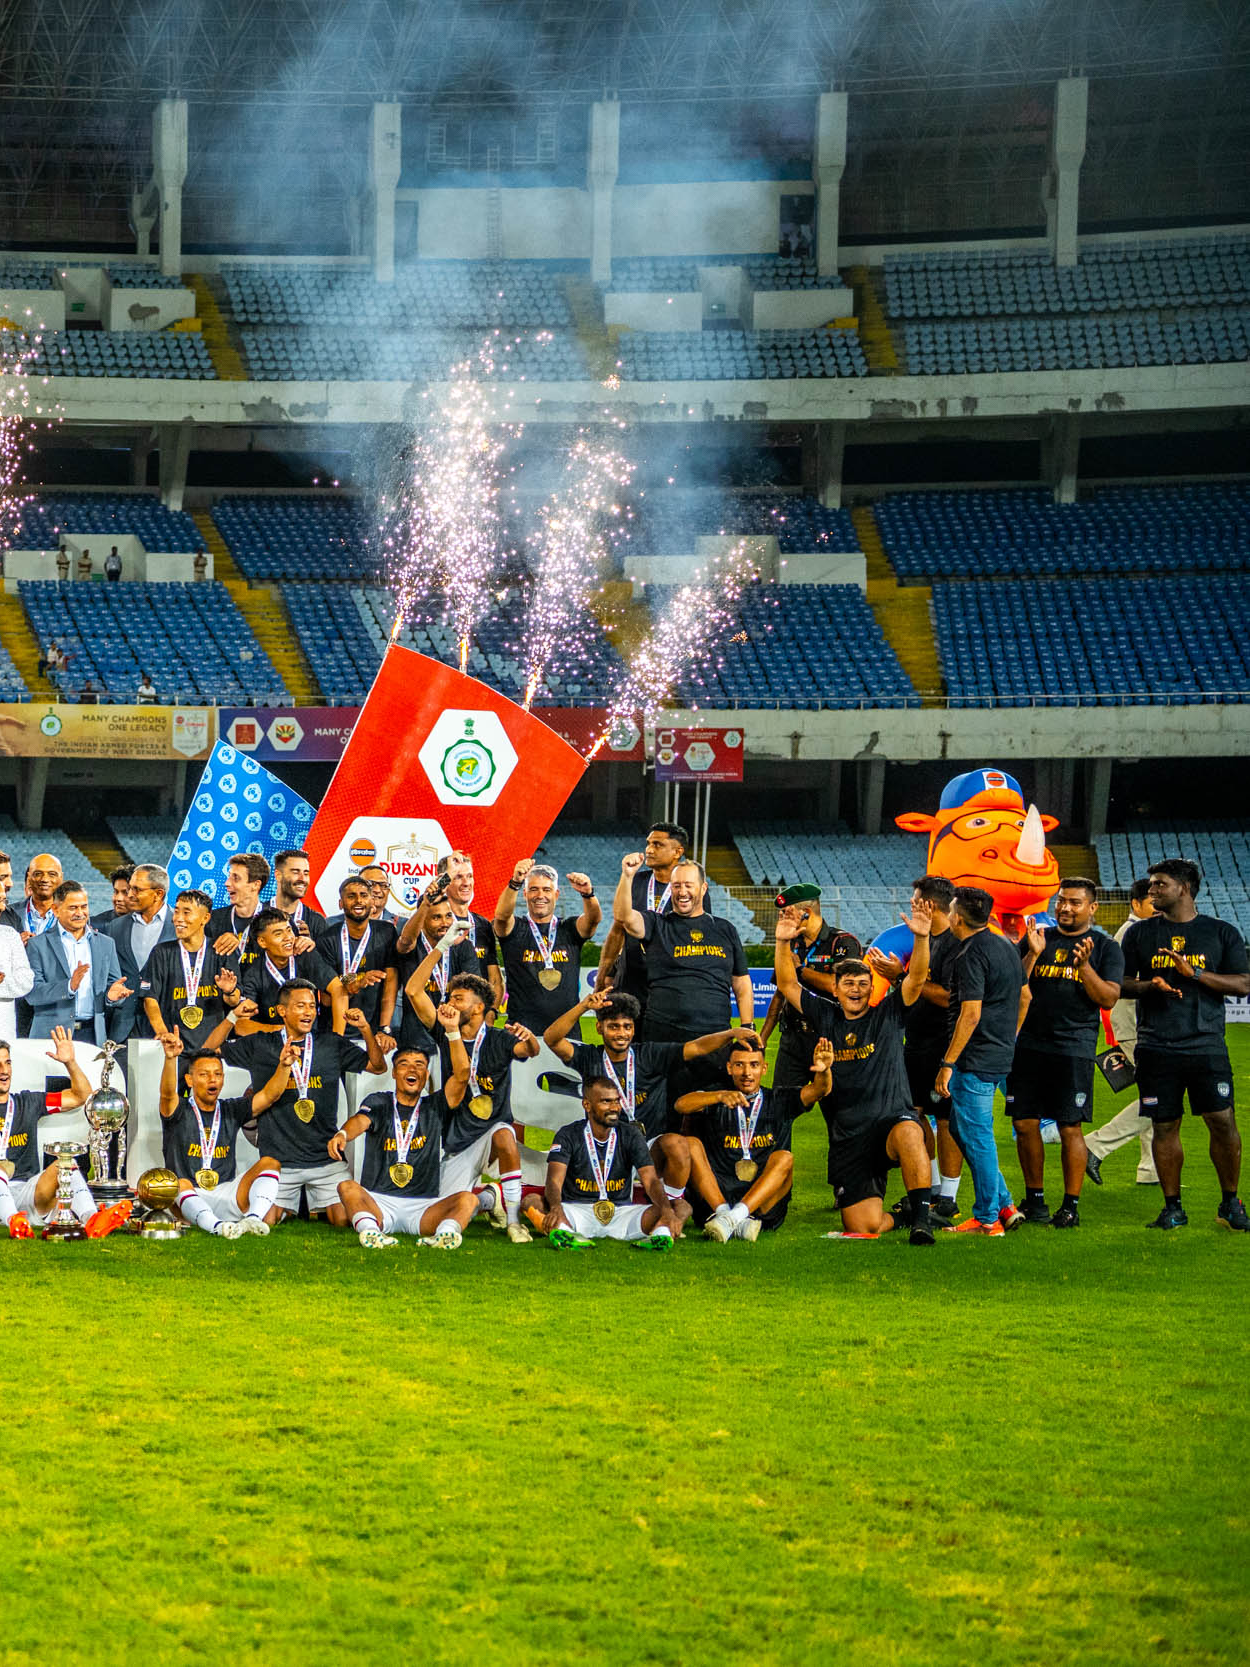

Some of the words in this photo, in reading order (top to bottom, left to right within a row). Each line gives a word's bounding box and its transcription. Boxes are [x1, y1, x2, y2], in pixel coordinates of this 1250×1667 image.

[82, 715, 108, 723] MANY
[112, 716, 167, 724] CHAMPIONS
[108, 723, 128, 731] ONE
[314, 728, 341, 736] MANY
[403, 877, 420, 885] CUP
